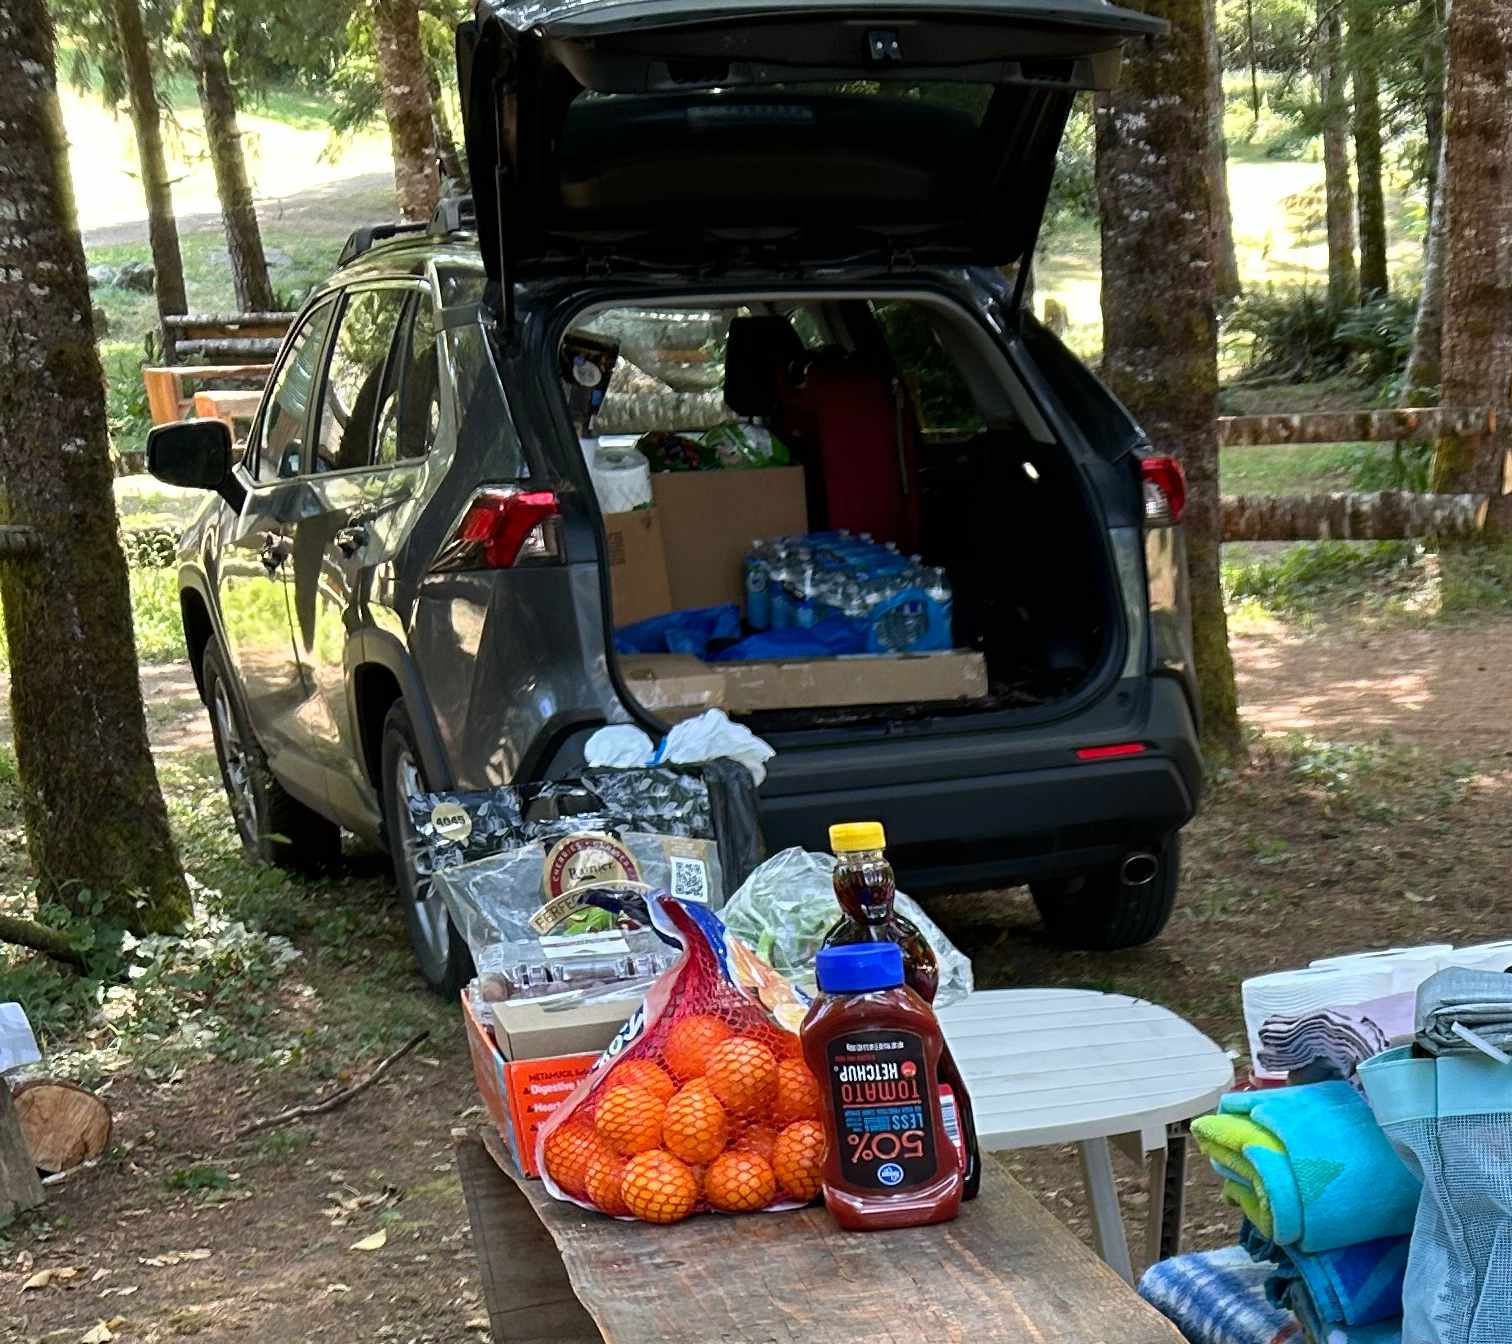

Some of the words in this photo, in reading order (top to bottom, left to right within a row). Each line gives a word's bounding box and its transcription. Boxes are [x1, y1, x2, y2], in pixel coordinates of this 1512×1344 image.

[839, 1062, 899, 1082] KETCHUP
[841, 1080, 920, 1103] TOMATO
[891, 1113, 924, 1130] LESS
[847, 1130, 925, 1163] 50%
